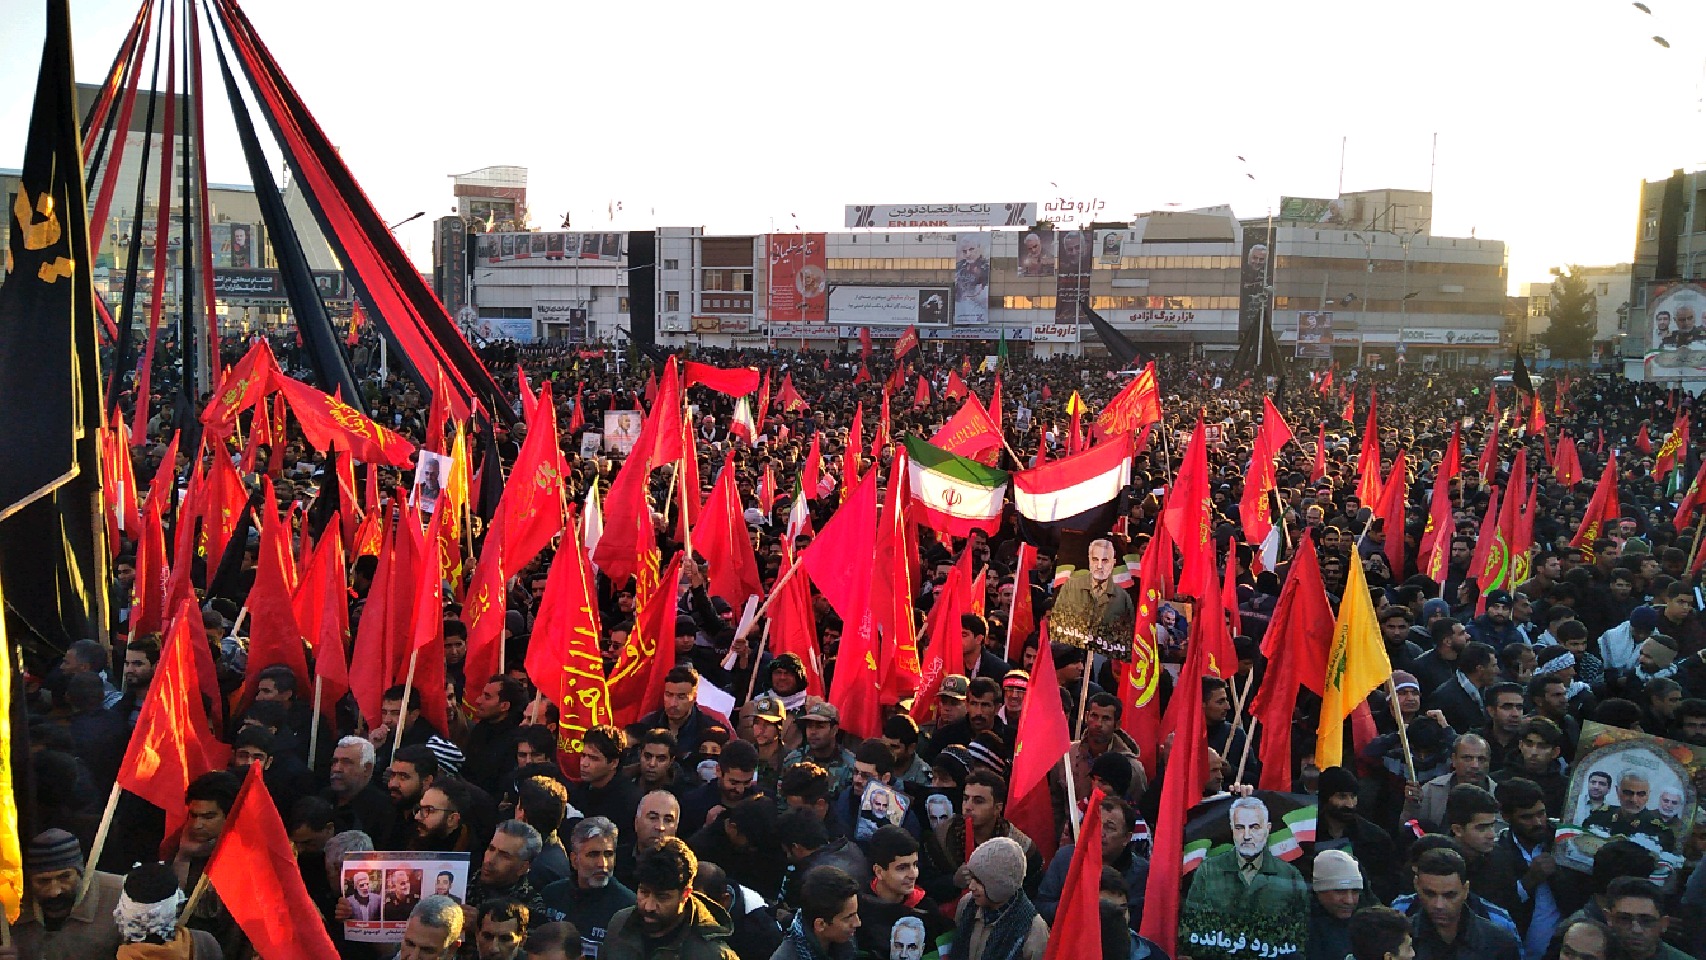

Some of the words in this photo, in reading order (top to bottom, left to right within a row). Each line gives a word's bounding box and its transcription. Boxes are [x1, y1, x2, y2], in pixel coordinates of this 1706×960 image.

[917, 203, 958, 214] اقتصاد
[957, 203, 991, 213] بانک
[1044, 197, 1105, 213] داروخانه
[888, 206, 918, 218] نوین
[1130, 310, 1154, 322] آزادی
[1154, 310, 1176, 322] بزرگ
[1176, 310, 1194, 322] بازار
[1034, 324, 1077, 338] داروخانه
[1190, 930, 1246, 954] فرمانده
